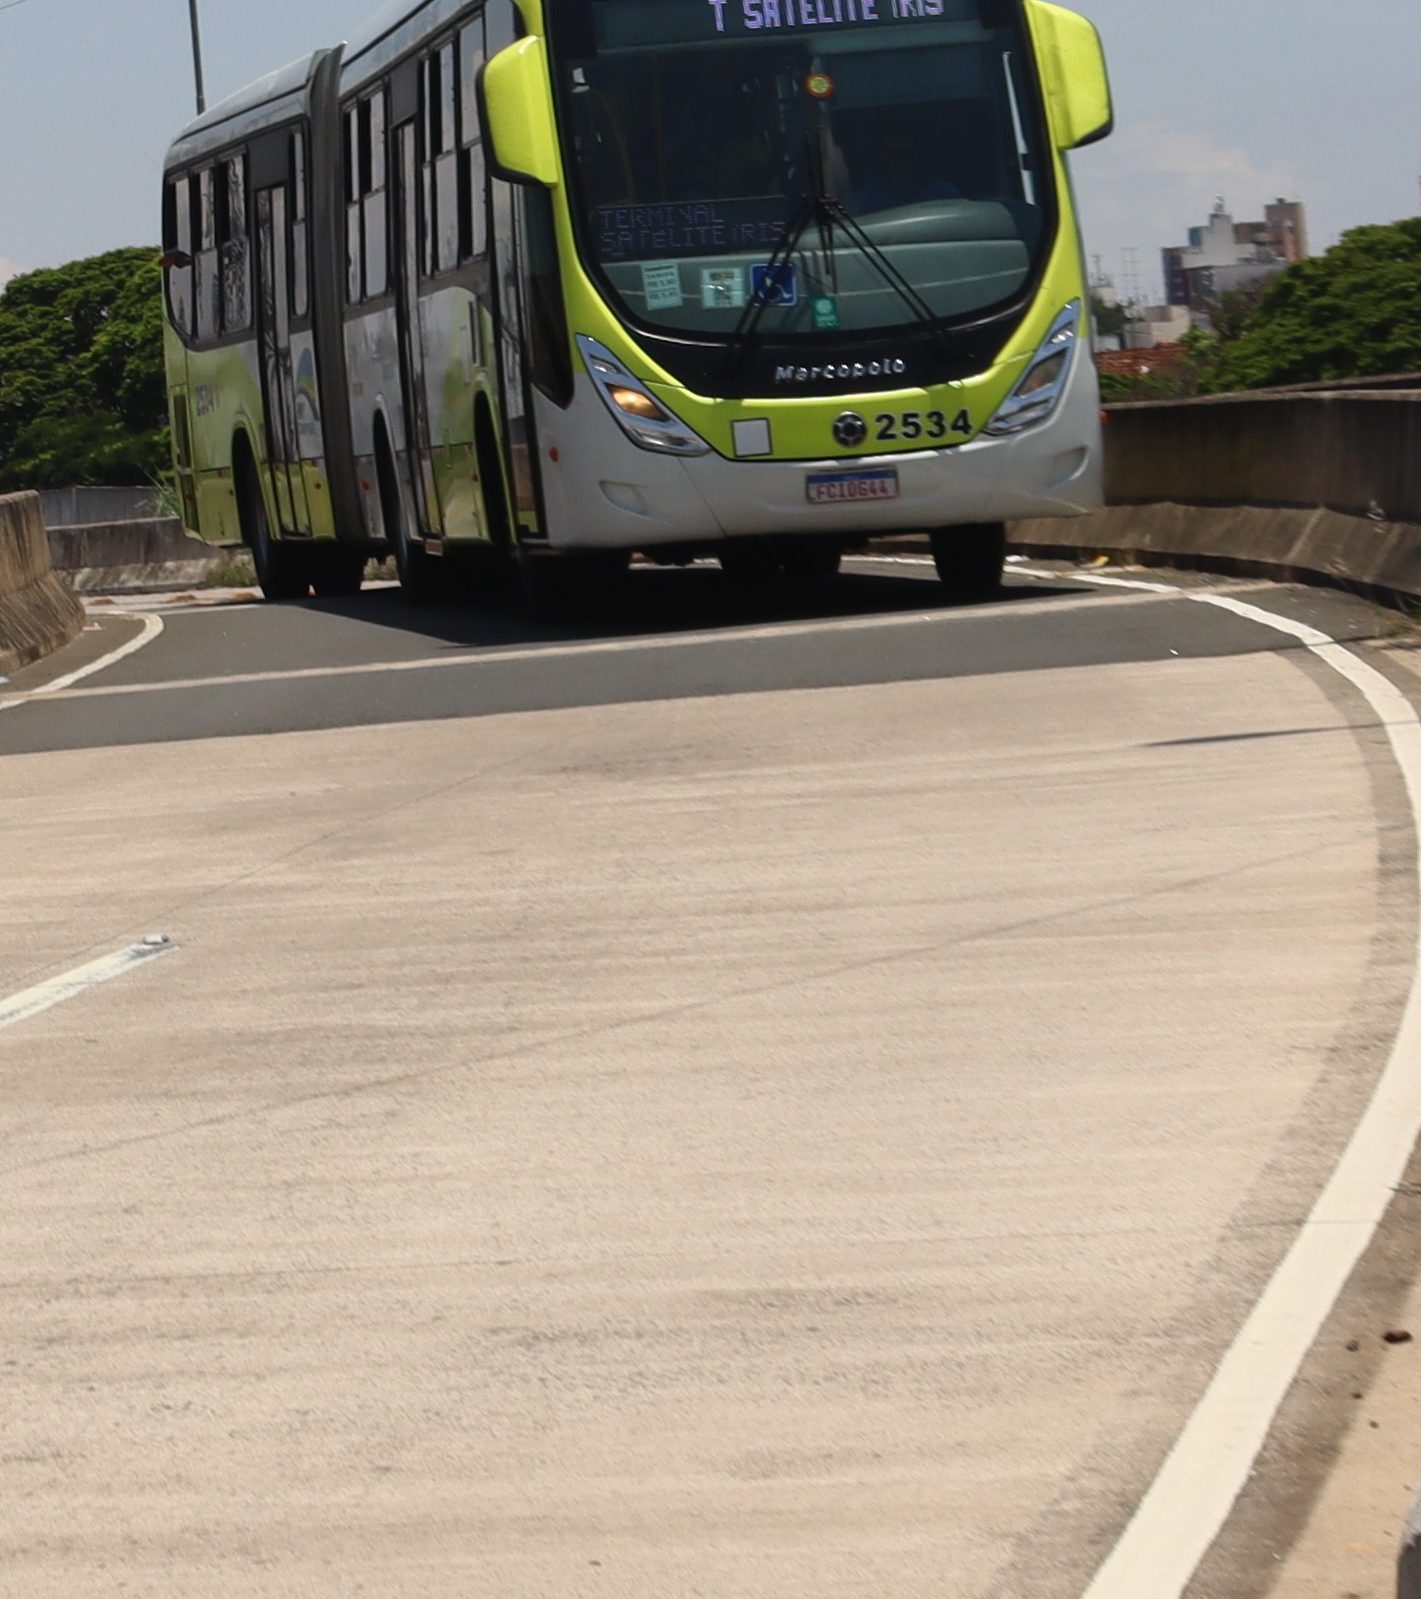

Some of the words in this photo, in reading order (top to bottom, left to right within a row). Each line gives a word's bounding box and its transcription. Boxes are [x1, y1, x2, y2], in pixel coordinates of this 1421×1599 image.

[597, 203, 725, 230] TERMINAL
[775, 358, 906, 383] Marcopolo
[875, 408, 973, 441] 2534
